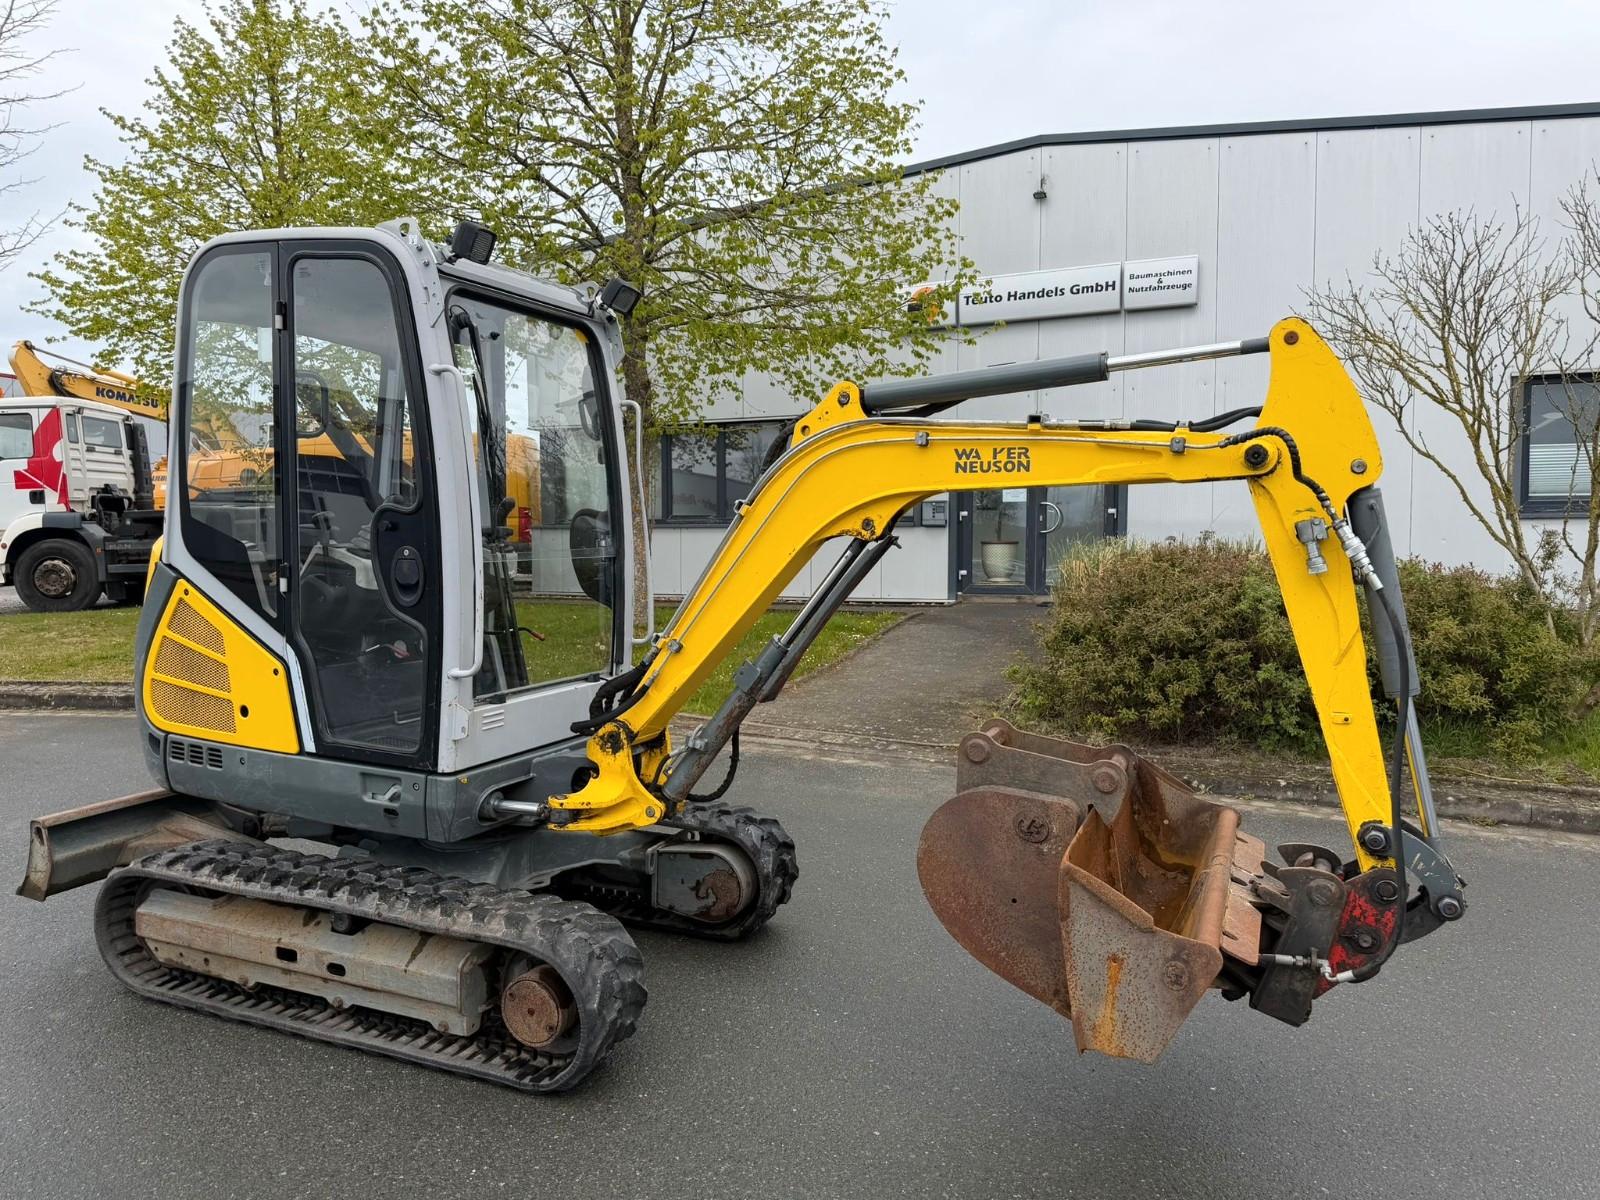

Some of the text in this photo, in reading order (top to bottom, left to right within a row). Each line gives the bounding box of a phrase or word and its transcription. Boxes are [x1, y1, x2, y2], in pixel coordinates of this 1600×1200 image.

[1129, 269, 1193, 280] Baumaschinen
[1006, 286, 1066, 302] Handels
[1069, 280, 1117, 296] GmbH
[1128, 282, 1193, 294] Nutzfahrzeuge
[953, 447, 1031, 460] WAKER
[954, 460, 1031, 473] NEUSON
